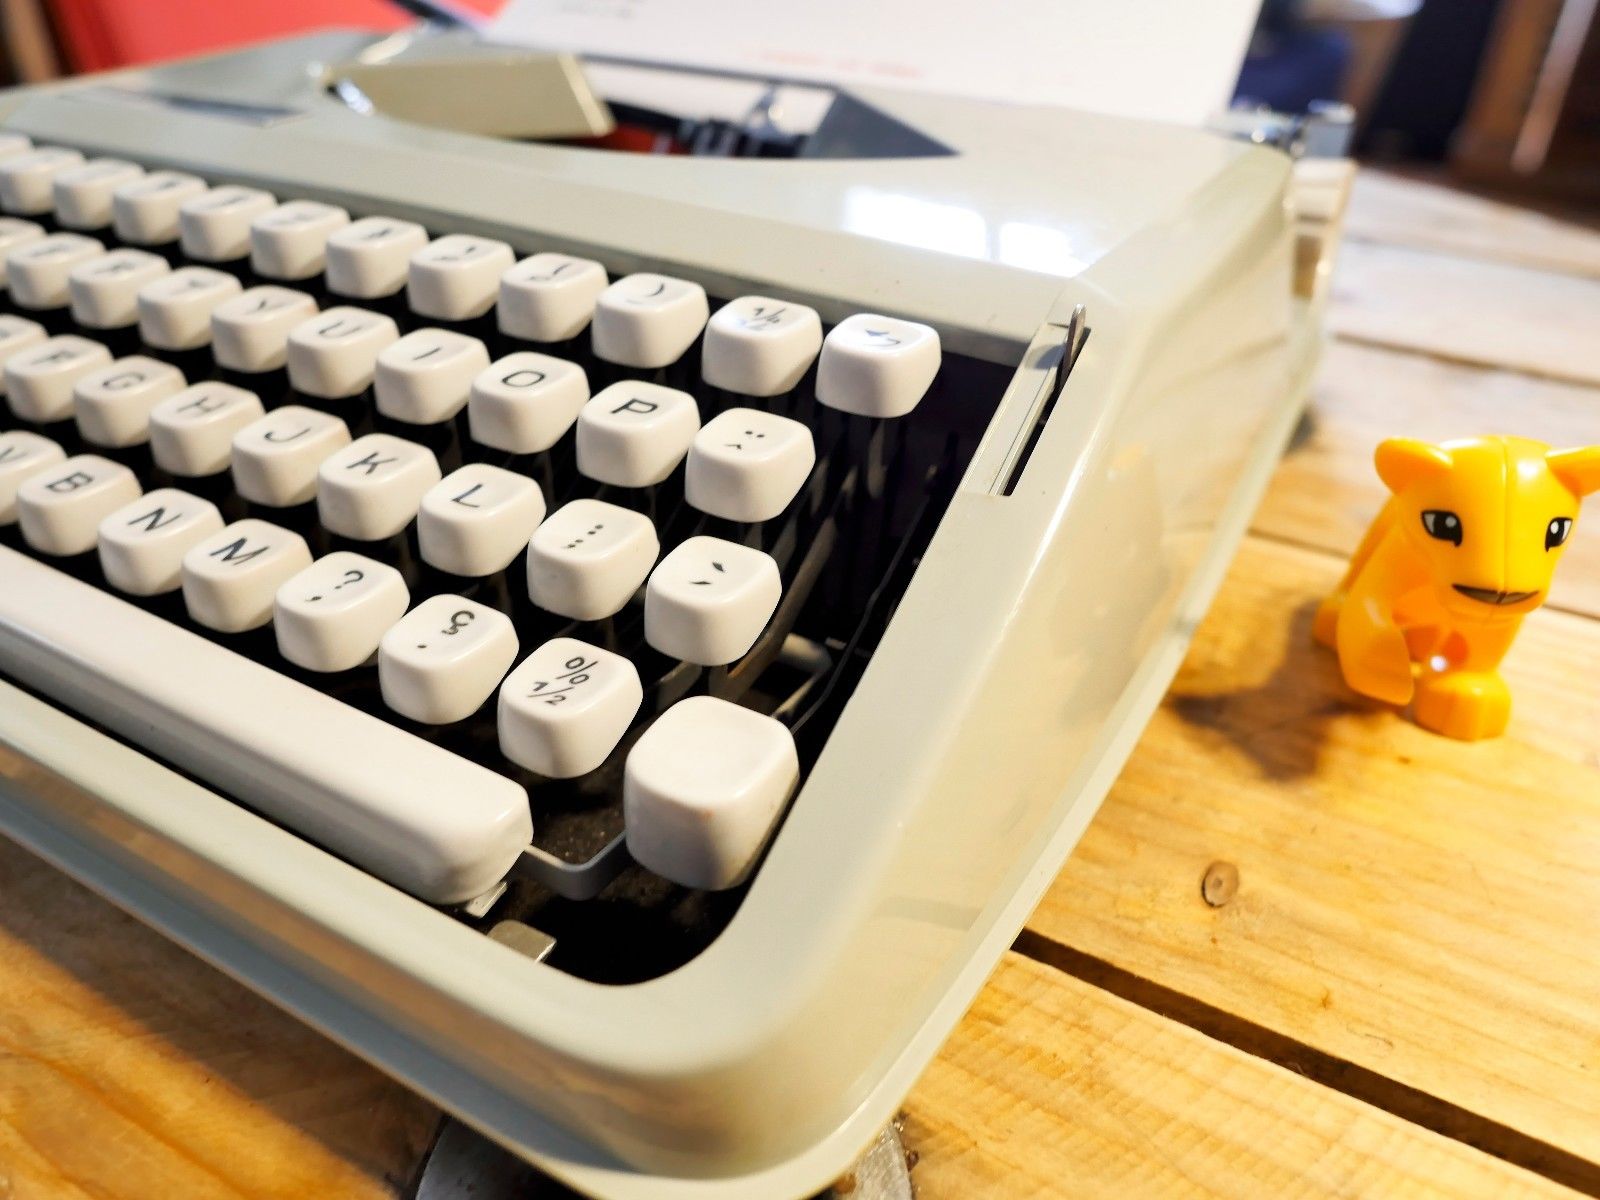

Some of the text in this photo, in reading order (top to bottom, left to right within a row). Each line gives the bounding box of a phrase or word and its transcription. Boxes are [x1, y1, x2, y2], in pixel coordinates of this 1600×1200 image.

[318, 320, 364, 338] U
[411, 346, 443, 361] I
[102, 371, 147, 390] G
[501, 370, 545, 388] O
[611, 398, 659, 415] P
[263, 427, 312, 443] J
[345, 452, 399, 475] K
[45, 471, 94, 493] B
[450, 483, 484, 509] L
[127, 506, 183, 532] N
[209, 536, 271, 566] M
